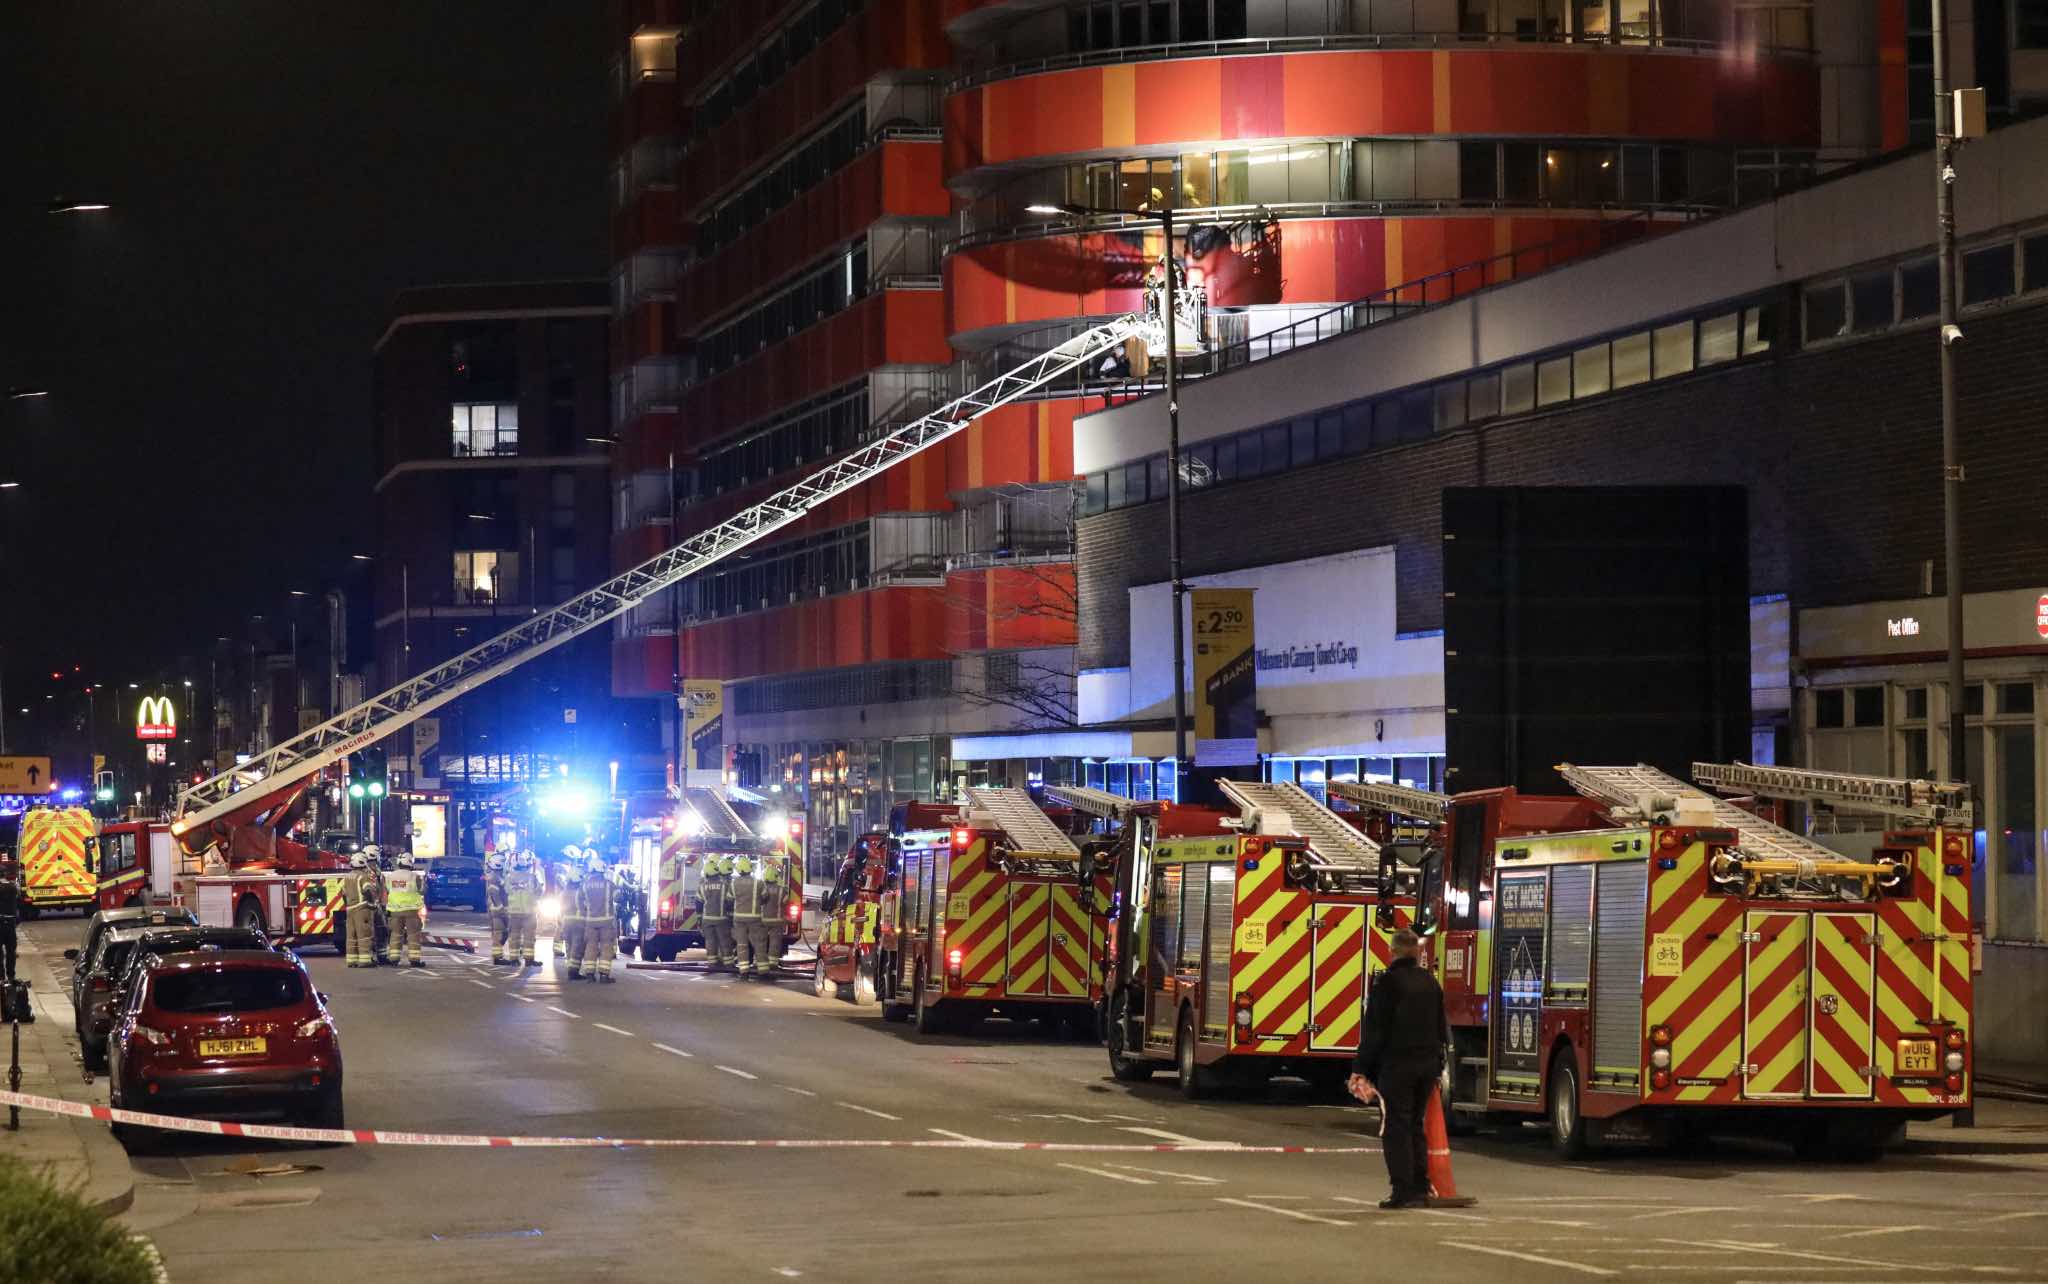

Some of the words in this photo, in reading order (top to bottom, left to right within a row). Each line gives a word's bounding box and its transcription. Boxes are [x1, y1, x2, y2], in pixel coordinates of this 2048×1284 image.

[1198, 611, 1243, 633] £2.90
[1888, 619, 1901, 636] Post
[1902, 617, 1920, 635] Office
[334, 731, 375, 755] MAGIRUS
[1905, 1056, 1929, 1068] EYT
